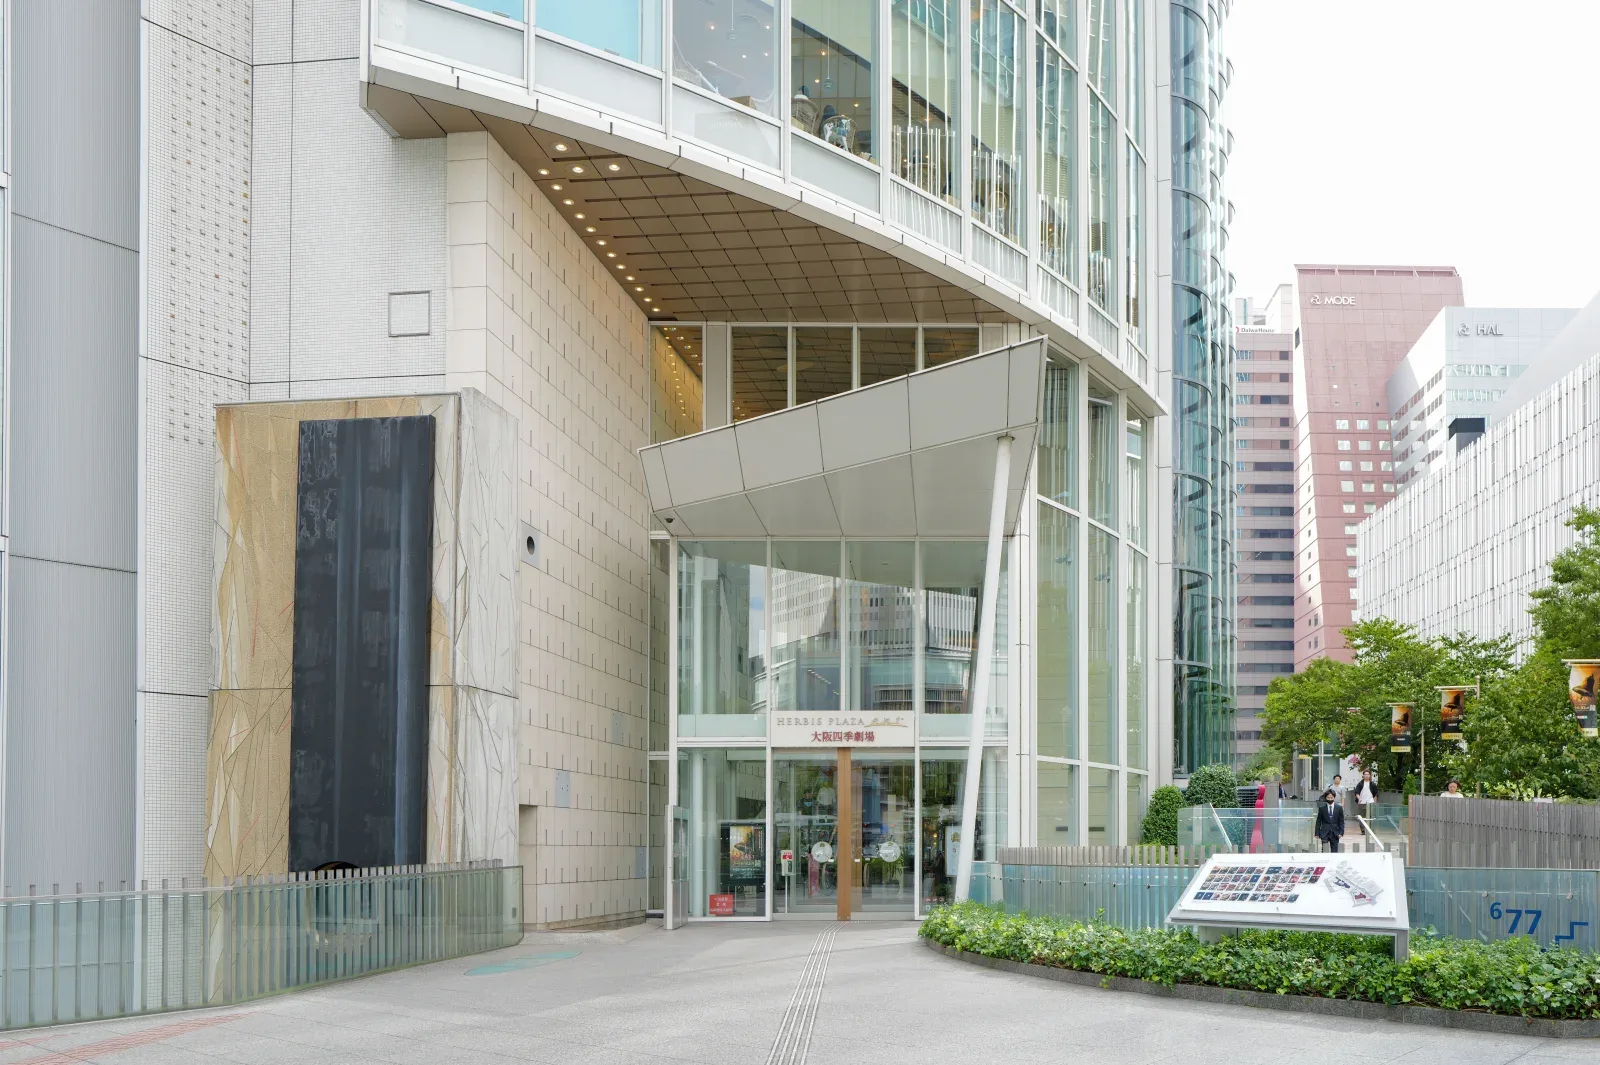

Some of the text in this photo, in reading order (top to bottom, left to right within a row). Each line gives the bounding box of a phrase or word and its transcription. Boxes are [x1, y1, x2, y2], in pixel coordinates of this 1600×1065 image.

[1324, 296, 1356, 305] MODE
[1476, 323, 1504, 336] HAL
[776, 717, 823, 726] HERBIS
[828, 717, 865, 726] PLAZA
[811, 731, 875, 742] 大阪四季劇場
